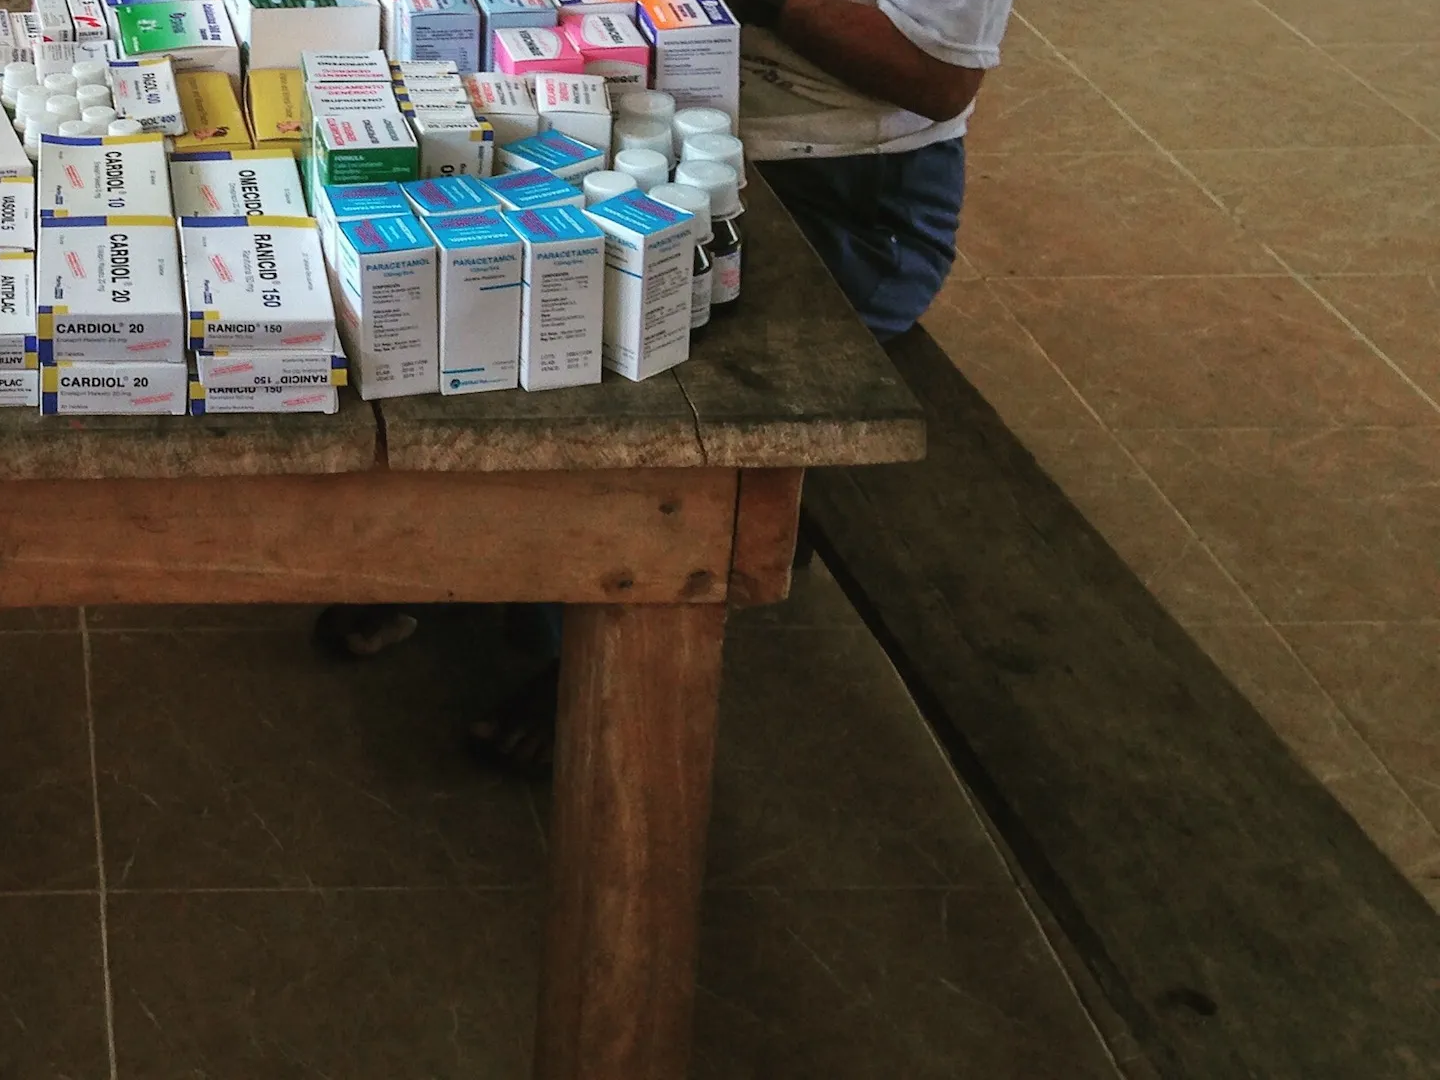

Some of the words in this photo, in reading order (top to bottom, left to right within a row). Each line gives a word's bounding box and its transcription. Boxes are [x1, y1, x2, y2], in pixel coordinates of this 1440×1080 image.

[161, 115, 177, 123] 400
[105, 151, 124, 193] CARDIOL
[108, 197, 125, 208] 10
[1, 195, 15, 224] VASODIL
[110, 234, 129, 283] CARDIOL
[254, 234, 278, 280] RANICID
[537, 247, 599, 261] PARACETAMOL
[366, 258, 430, 272] PARACETAMOL
[453, 255, 517, 267] PARACETAMOL
[1, 275, 15, 314] ANTIPLAC
[112, 290, 131, 303] 20
[261, 289, 282, 308] 150
[56, 323, 121, 334] CARDIOL
[129, 323, 144, 334] 20
[208, 324, 256, 333] RANICID
[264, 324, 282, 333] 150
[60, 377, 125, 388] CARDIOL
[133, 377, 149, 388] 20
[254, 376, 271, 384] 150
[280, 375, 327, 384] RANICID
